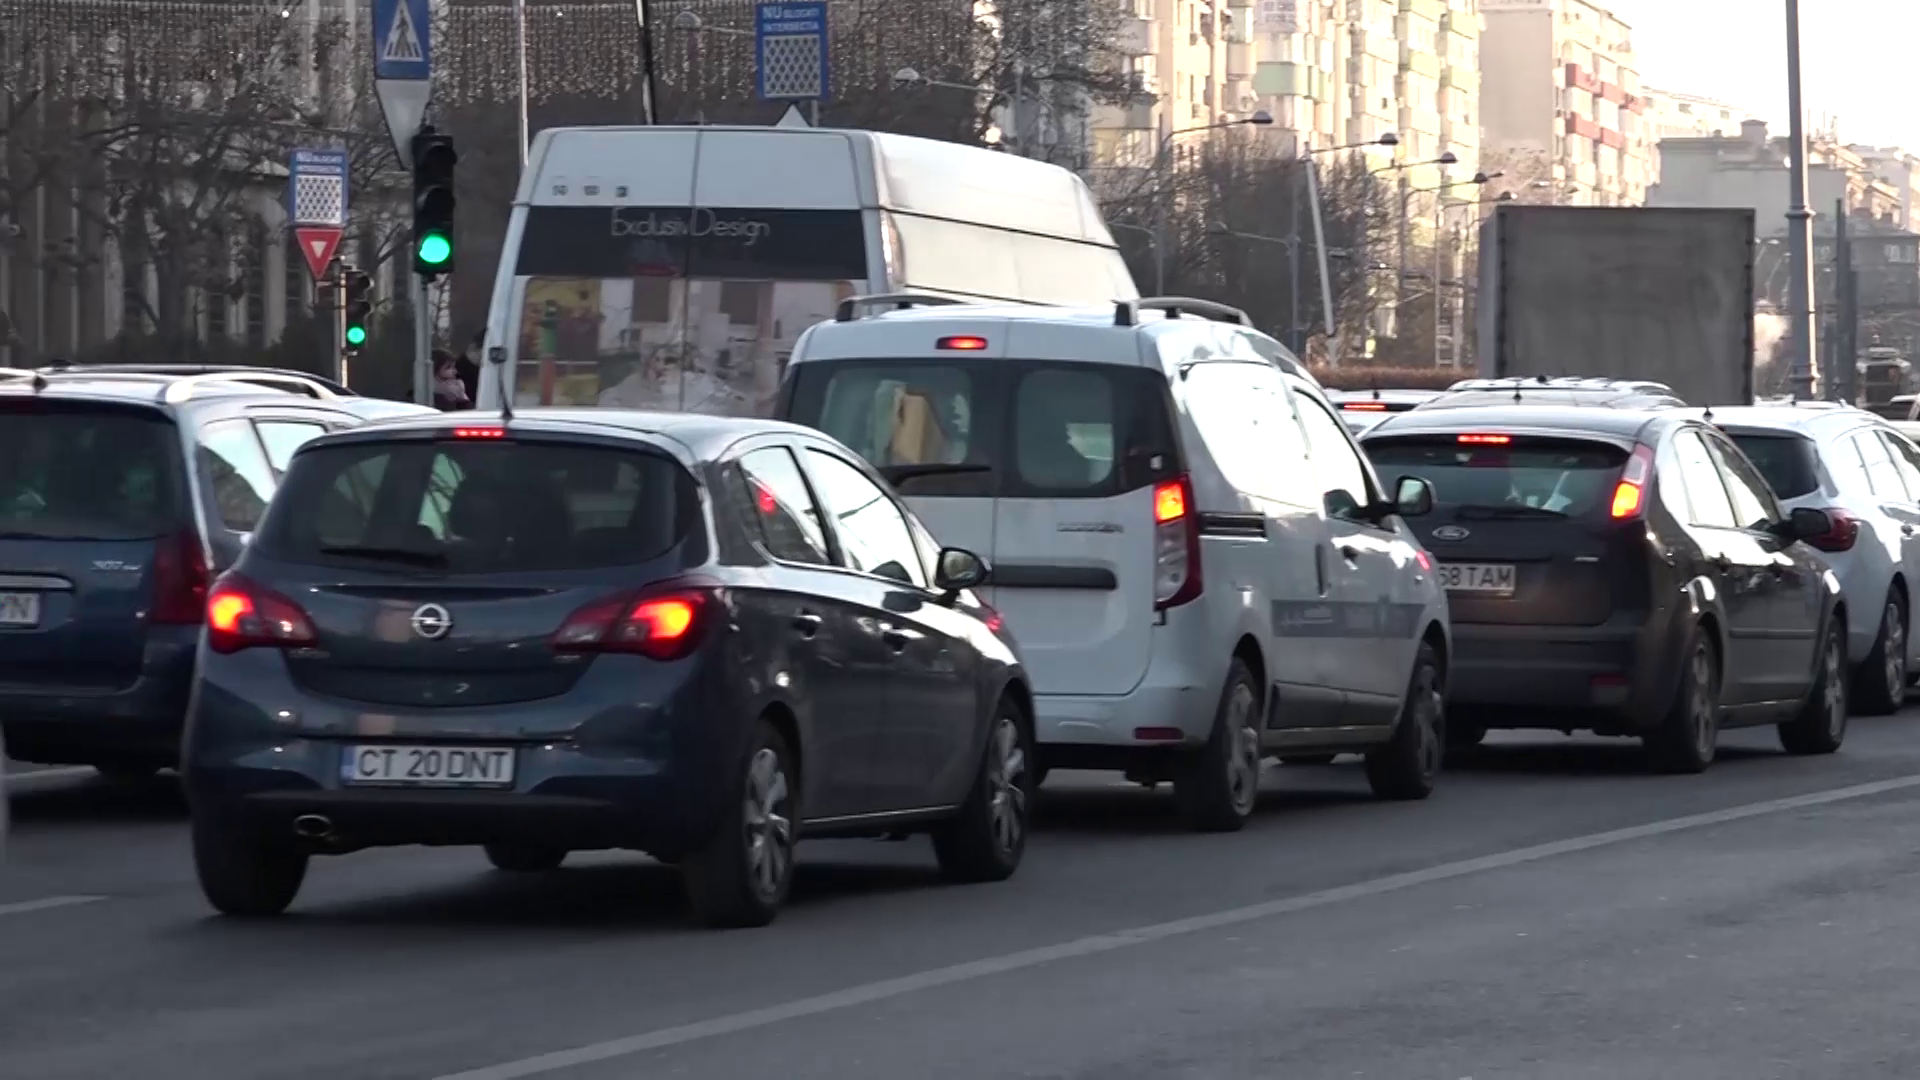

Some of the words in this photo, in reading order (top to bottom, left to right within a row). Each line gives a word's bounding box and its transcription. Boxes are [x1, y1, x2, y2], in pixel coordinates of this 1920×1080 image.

[762, 6, 781, 19] NU
[1466, 567, 1512, 588] TAM
[359, 749, 397, 777] CT
[405, 750, 441, 778] 20
[446, 751, 508, 778] DNT
